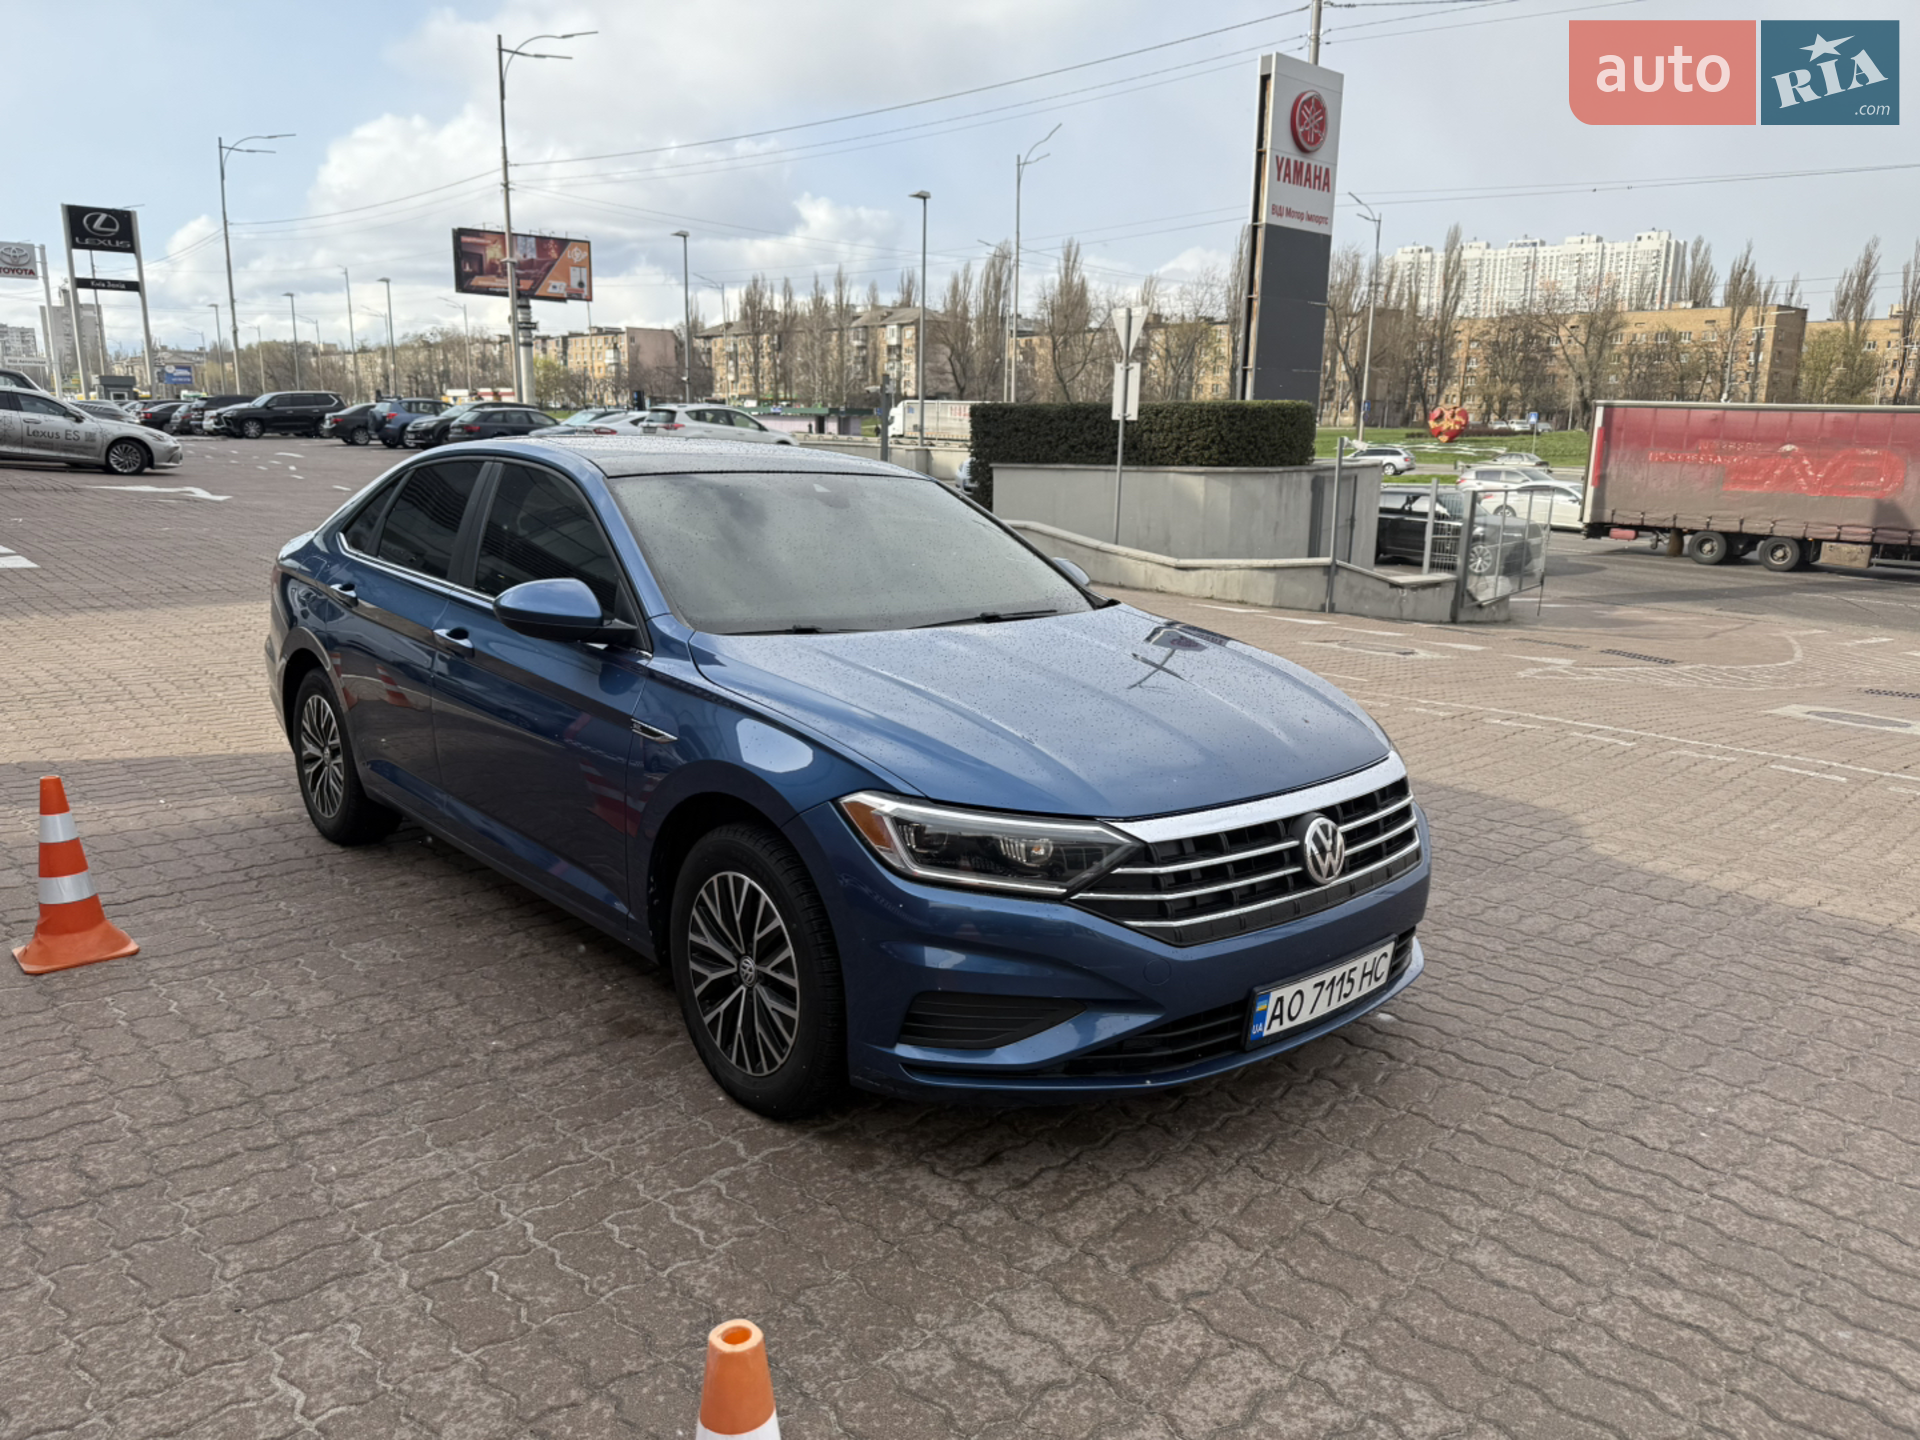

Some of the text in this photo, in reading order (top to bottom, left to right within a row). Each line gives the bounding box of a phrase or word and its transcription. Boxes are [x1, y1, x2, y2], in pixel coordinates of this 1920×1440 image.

[1275, 155, 1331, 193] YAMAHA
[1271, 203, 1284, 217] ВІДІ
[1285, 207, 1305, 222] Мотор
[75, 236, 131, 249] LEXUS
[0, 266, 35, 276] TOYOTA
[26, 425, 80, 442] Lexus ES
[1266, 952, 1389, 1031] AO 7115 HC
[1251, 1022, 1264, 1036] UA
